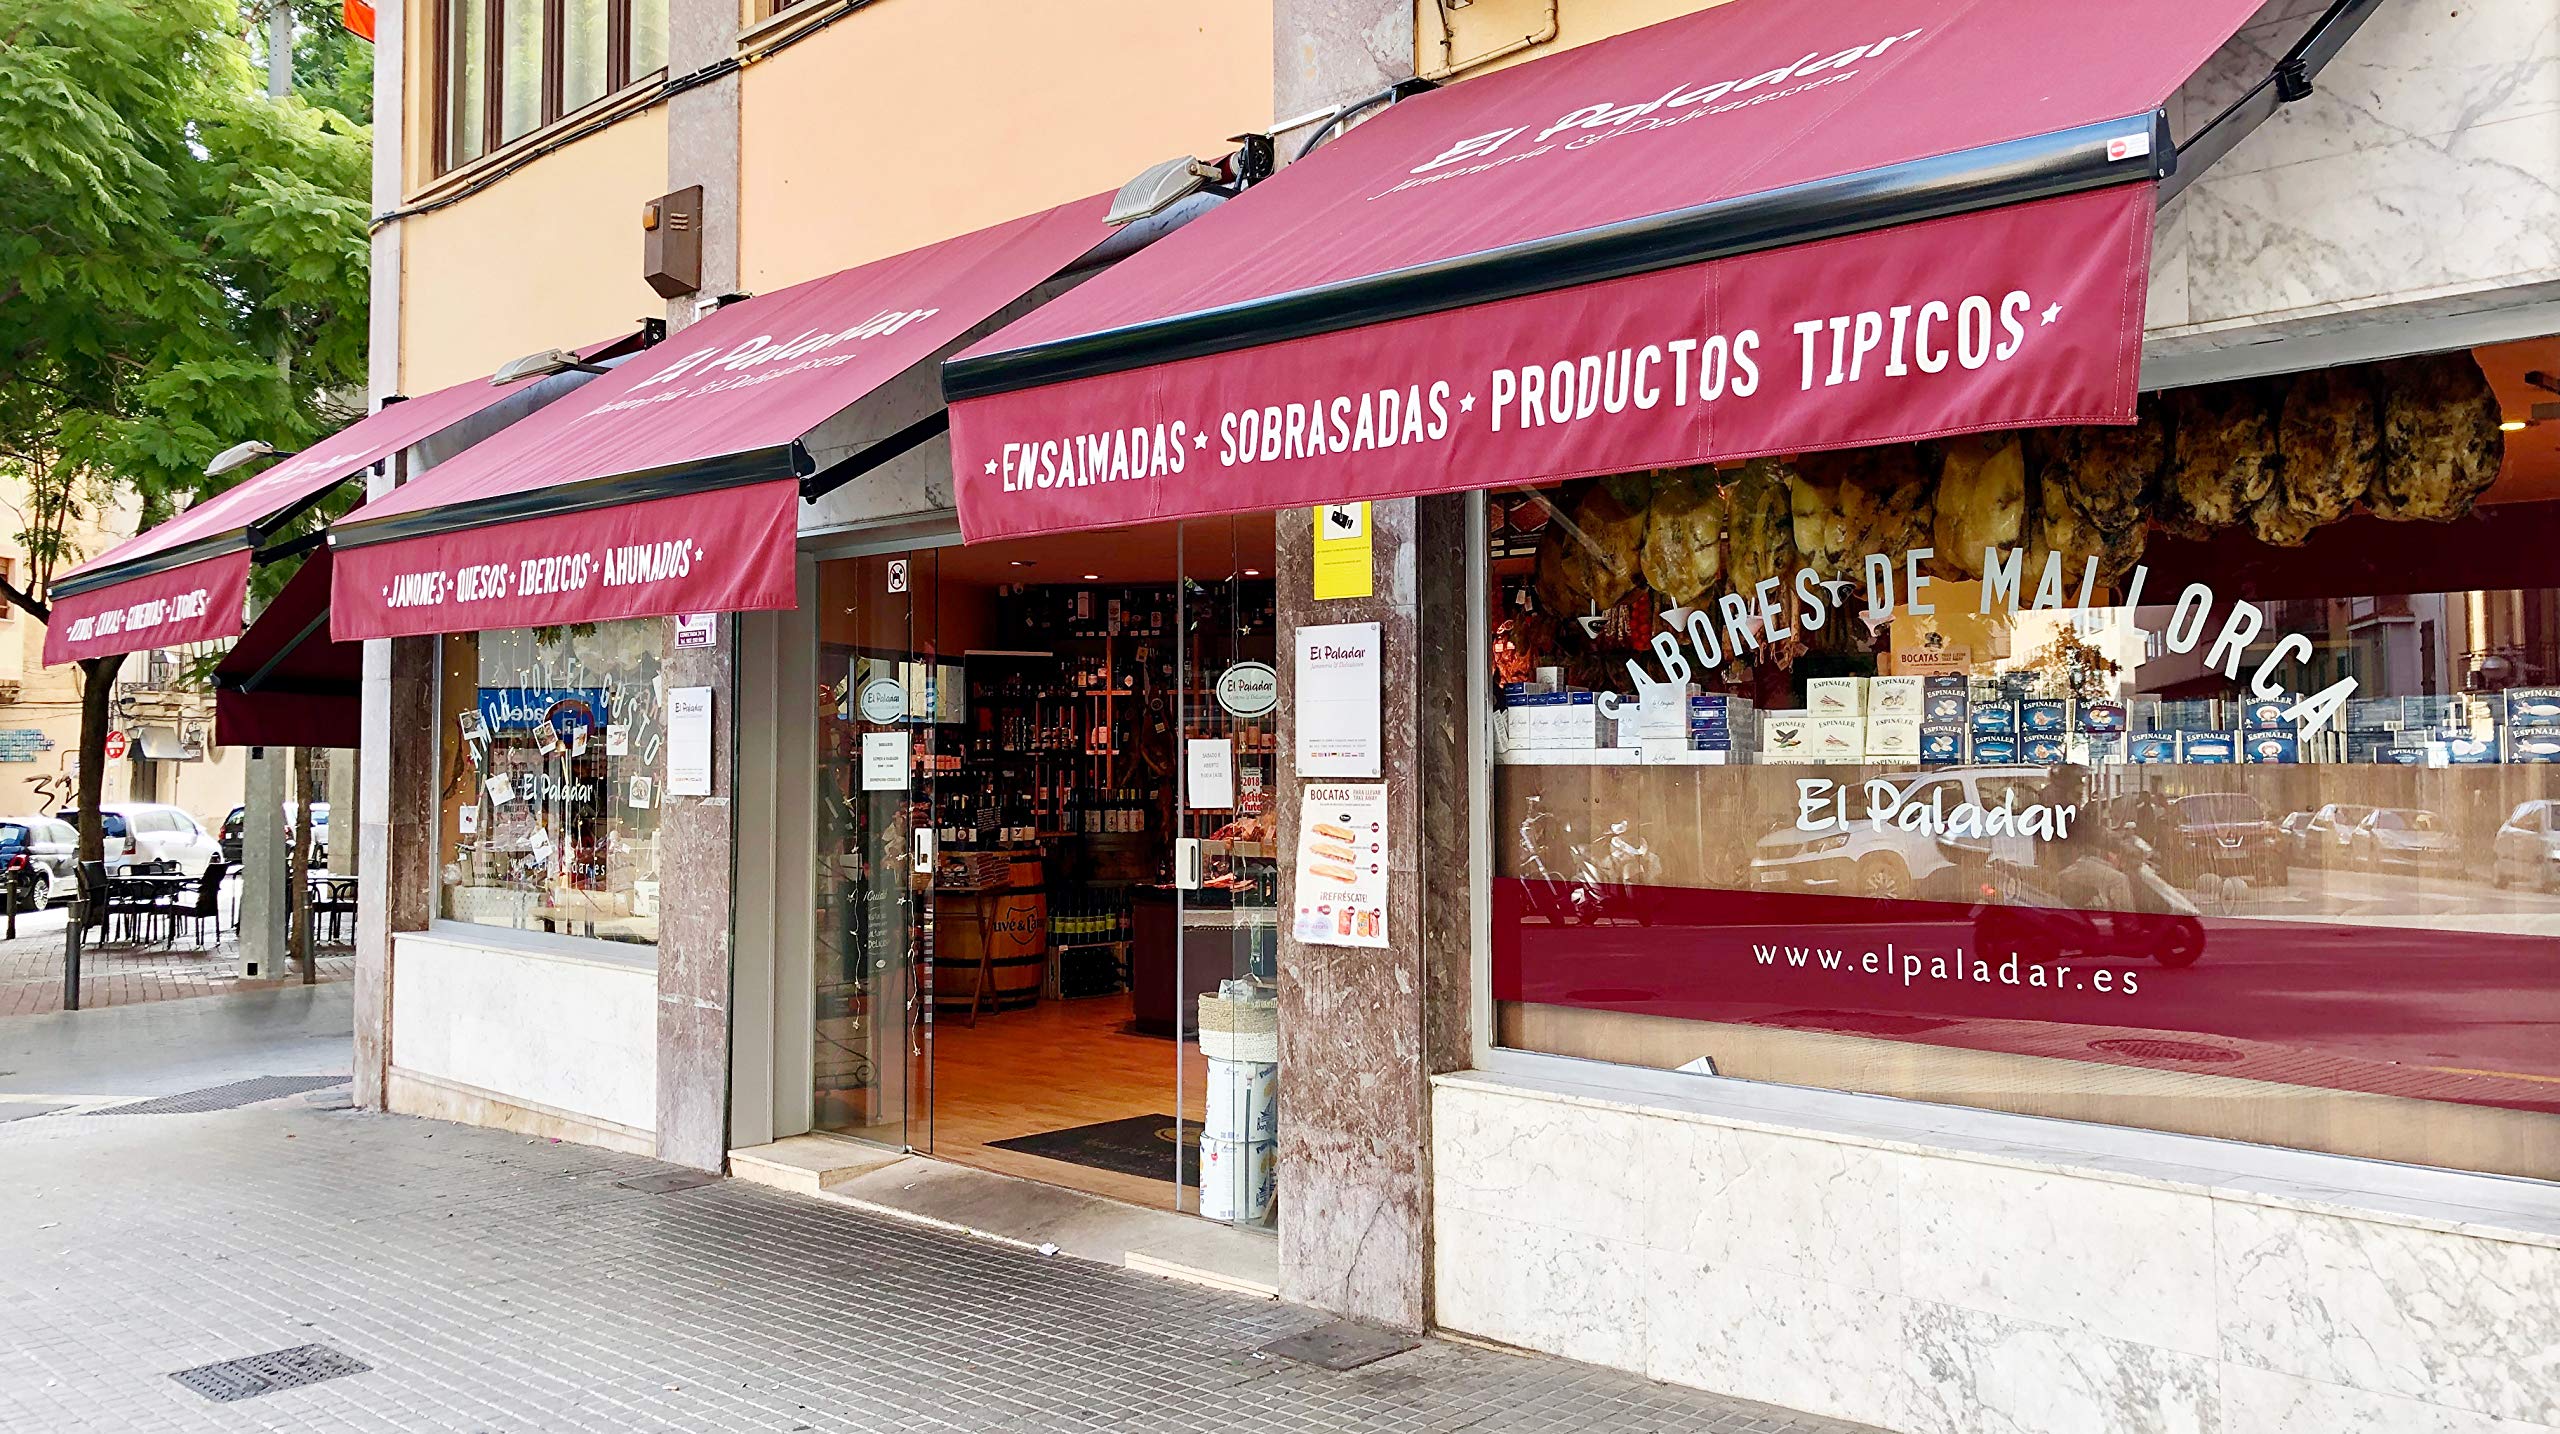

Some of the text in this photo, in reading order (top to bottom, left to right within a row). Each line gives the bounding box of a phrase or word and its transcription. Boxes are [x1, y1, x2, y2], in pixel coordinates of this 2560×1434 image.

[1409, 28, 1923, 174] El Paladar
[1607, 68, 1860, 140] Delicatessen
[625, 309, 940, 393] El Paladar
[1003, 290, 2031, 493] ENSAIMADAS SOBRASADAS PRODUCTOS TIPICOS
[388, 538, 693, 608] JAMONES QUESOS IBERICOS AHUMADOS
[1865, 548, 1935, 620] DE
[1980, 547, 2359, 742] MALLORCA
[1310, 645, 1366, 660] El Paladar
[1901, 653, 1939, 663] BOCATAS
[1227, 679, 1273, 692] El Paladar
[1813, 680, 1851, 689] ESPINALER
[1876, 678, 1916, 687] ESPINALER
[1926, 689, 1966, 698] ESPINALER
[1973, 702, 2013, 713] ESPINALER
[2023, 701, 2063, 710] ESPINALER
[2080, 700, 2123, 709] ESPINALER
[519, 662, 553, 706] POR
[566, 657, 586, 697] EL
[600, 672, 661, 766] GUSTO
[1771, 721, 1806, 729] ESPINALER
[1818, 720, 1856, 729] ESPINALER
[1875, 718, 1914, 726] ESPINALER
[1922, 725, 1962, 735] ESPINALER
[1974, 735, 2015, 744] ESPINALER
[2023, 734, 2064, 743] ESPINALER
[2131, 733, 2173, 742] ESPINALER
[2186, 732, 2231, 742] ESPINALER
[2247, 731, 2293, 741] ESPINALER
[2387, 748, 2424, 757] ESPINALER
[1242, 777, 1260, 787] 2018
[522, 773, 537, 801] El
[541, 773, 593, 804] Paladar
[1310, 789, 1350, 801] BOCATAS
[1794, 778, 2076, 843] El Paladar
[1752, 943, 2139, 995] www.elpaladar.es
